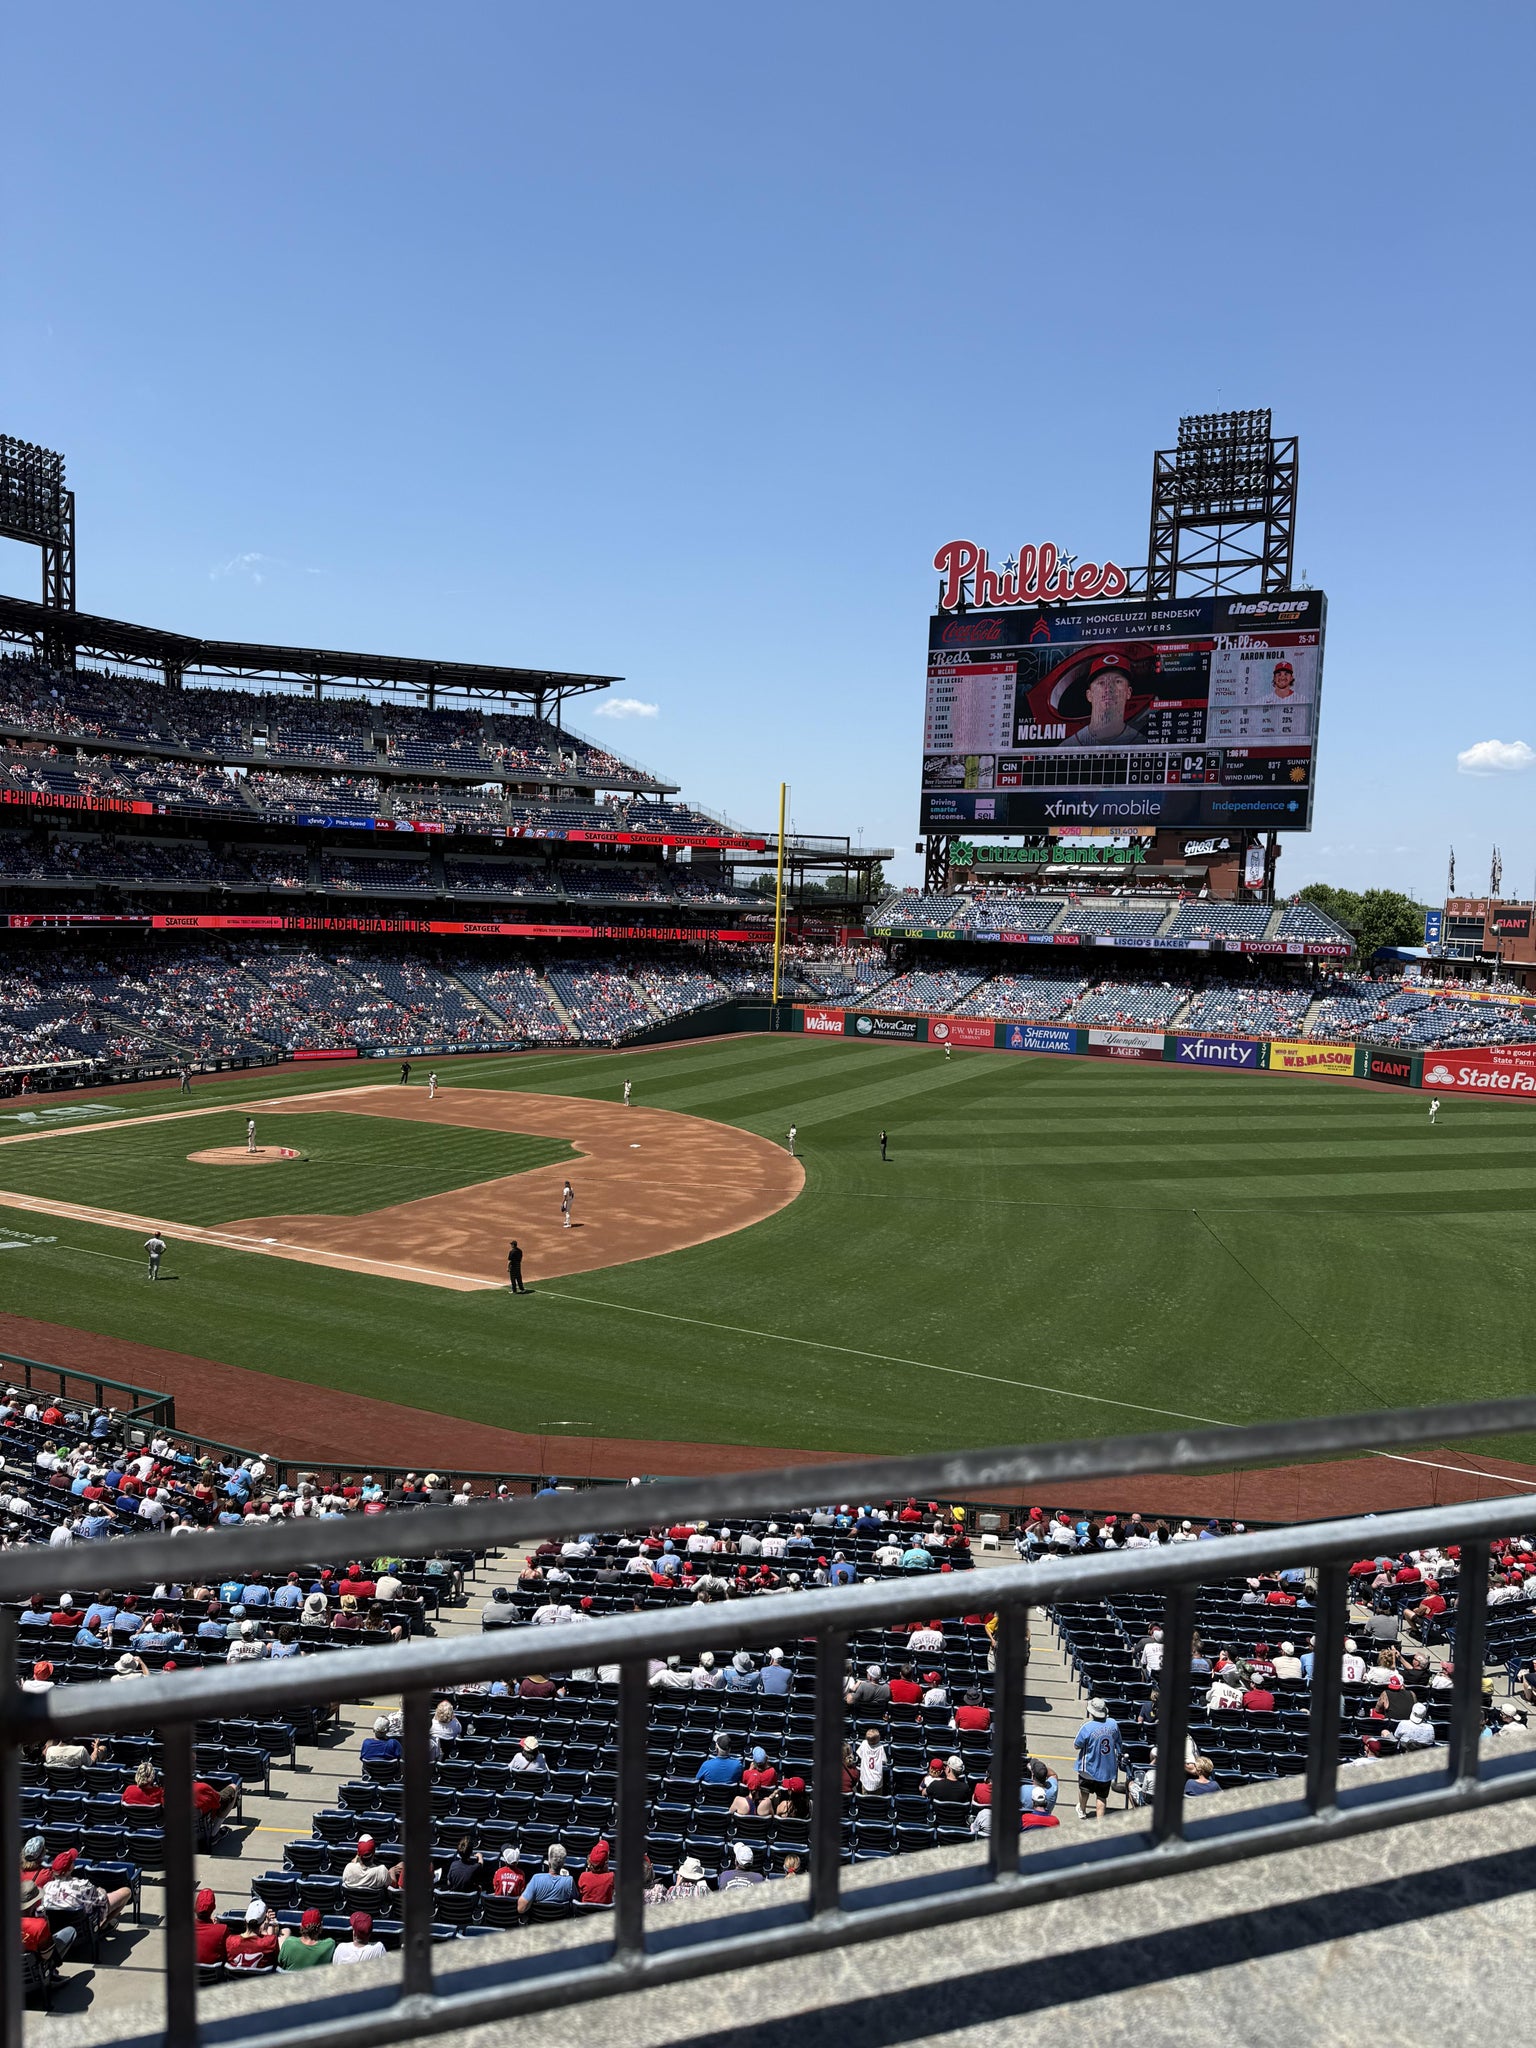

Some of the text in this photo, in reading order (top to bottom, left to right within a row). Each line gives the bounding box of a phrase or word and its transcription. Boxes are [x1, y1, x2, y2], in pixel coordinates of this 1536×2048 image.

[933, 539, 1127, 609] Phillies
[1228, 600, 1309, 616] theScore
[1055, 609, 1202, 626] SALTZ MONGELUZZI BENDESKY
[942, 618, 1004, 643] Coca-Cola
[1081, 624, 1172, 636] INJURY LAWYERS
[1213, 635, 1269, 650] Phillies
[933, 650, 972, 666] Reds
[1240, 652, 1264, 660] AARON
[1266, 651, 1285, 659] NOLA
[1244, 687, 1248, 695] 2
[1018, 724, 1066, 740] MCLAIN
[1002, 763, 1017, 771] CIN
[1184, 757, 1203, 771] 0-2
[1002, 776, 1017, 784] PHI
[11, 790, 90, 810] PHILADELPHIA
[91, 797, 134, 813] PHILLIES
[930, 799, 956, 807] Driving
[1212, 801, 1285, 811] Independence
[1044, 800, 1160, 818] xfinity mobile
[631, 834, 663, 843] SEATGEEK
[675, 837, 707, 845] SEATGEEK
[719, 839, 750, 847] SEATGEEK
[977, 844, 1147, 864] Citizens Bank Park
[1184, 838, 1222, 857] GHOST
[165, 917, 199, 926] SEATGEEK
[280, 917, 431, 932] THE PHILADELPHIA PHILLIES
[464, 924, 500, 932] SEATGEEK
[1496, 919, 1527, 928] GIANT
[590, 926, 719, 940] THE PHILADELPHIA PHILLIES
[874, 928, 955, 939] UKG UKG UKG
[1003, 933, 1079, 944] NECA NECA
[1114, 938, 1191, 949] LISCIO'S BAKERY
[1243, 942, 1347, 955] TOYOTA TOYOTA
[807, 1017, 842, 1032] Wawa
[873, 1019, 917, 1031] NovaCare
[968, 1028, 991, 1036] WEBB
[1026, 1028, 1069, 1040] SHERWIN
[1102, 1032, 1150, 1047] Yuengling
[1110, 1047, 1140, 1056] LAGER
[1181, 1039, 1252, 1063] xfinity
[1512, 1049, 1530, 1057] good
[1283, 1053, 1353, 1067] W.B.MASON
[1371, 1060, 1411, 1077] GIANT
[1347, 1667, 1354, 1679] 3
[1223, 1689, 1239, 1699] LIDGE
[1218, 1697, 1237, 1709] 54
[1101, 1738, 1110, 1755] 3
[868, 1757, 875, 1769] 3
[501, 1872, 518, 1881] HOSKINS
[502, 1881, 515, 1896] 17
